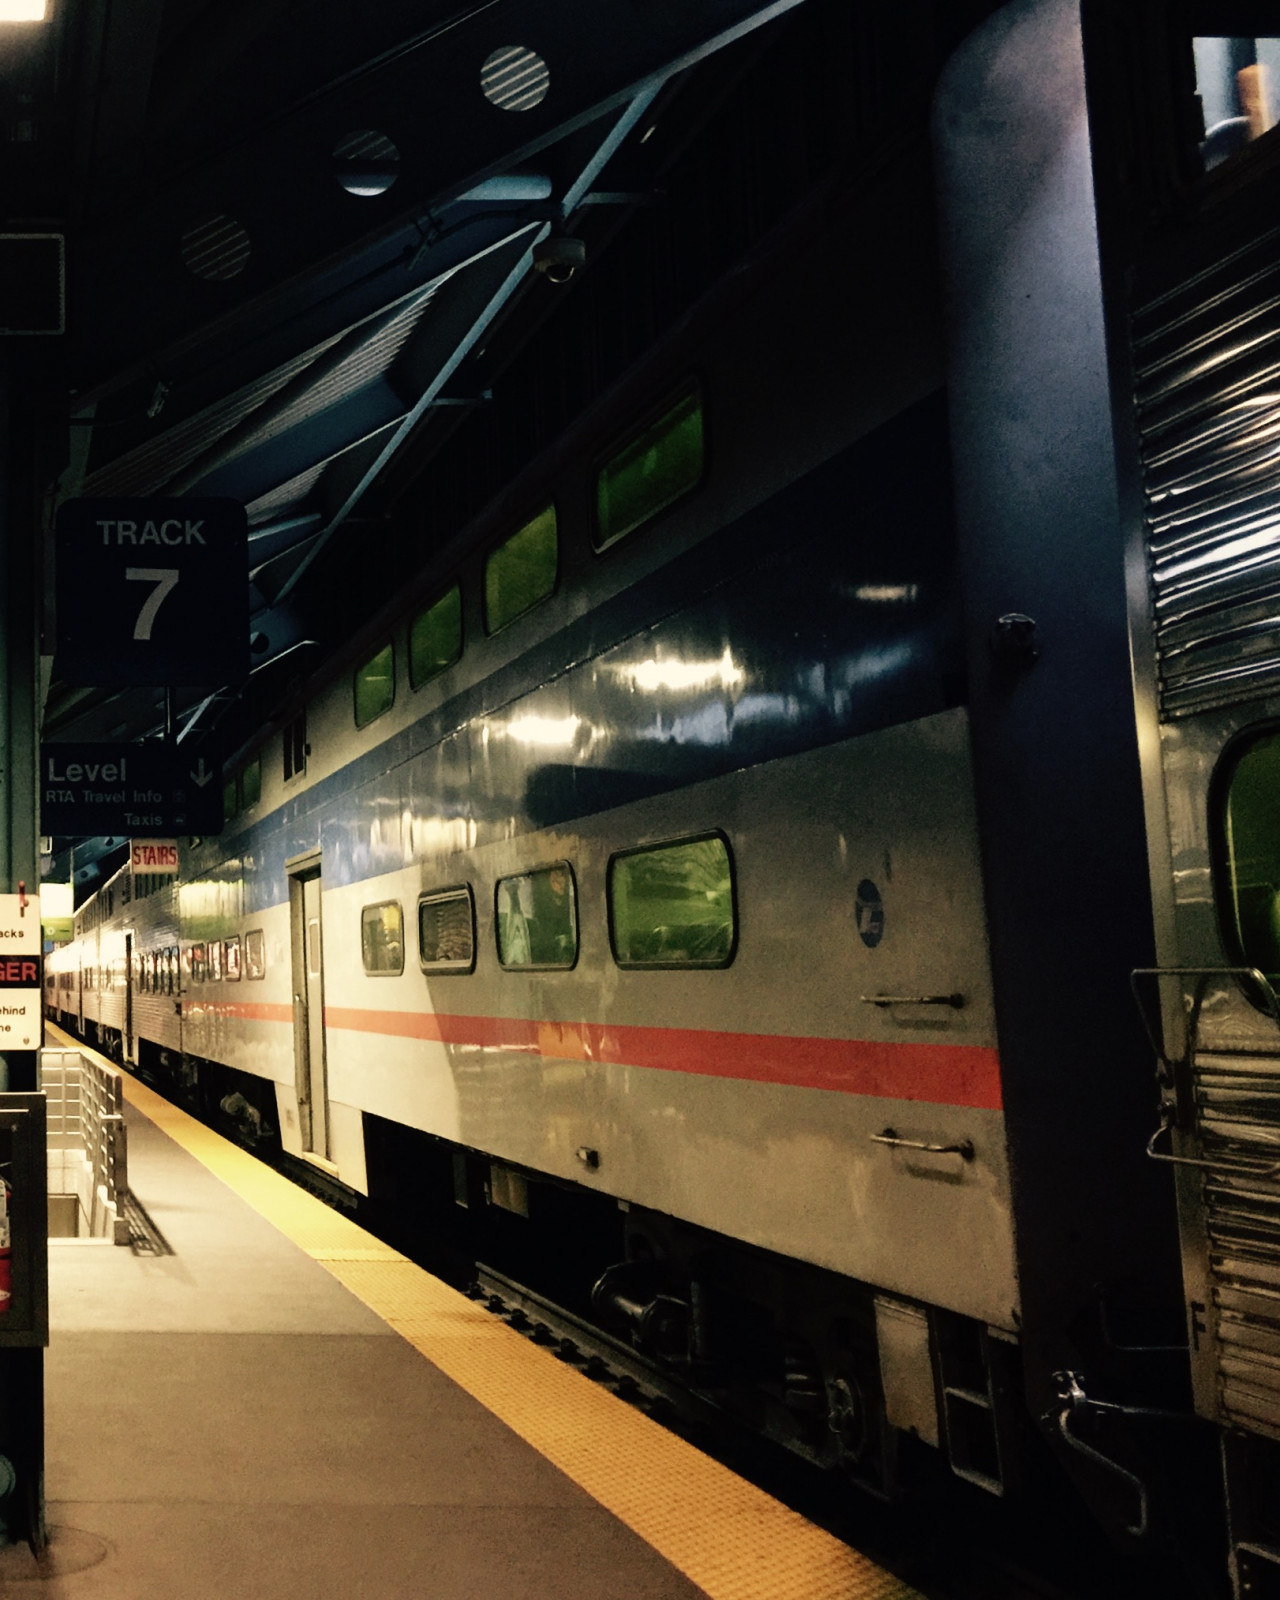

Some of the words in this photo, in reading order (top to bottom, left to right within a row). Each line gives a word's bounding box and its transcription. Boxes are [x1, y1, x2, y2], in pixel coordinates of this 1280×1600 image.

[96, 520, 207, 545] TRACK
[125, 567, 179, 640] 7
[48, 757, 127, 782] Level
[46, 790, 75, 803] RTA
[81, 789, 126, 803] Travel
[133, 789, 163, 803] Info
[124, 812, 163, 826] Taxis
[133, 846, 177, 865] STAIRS
